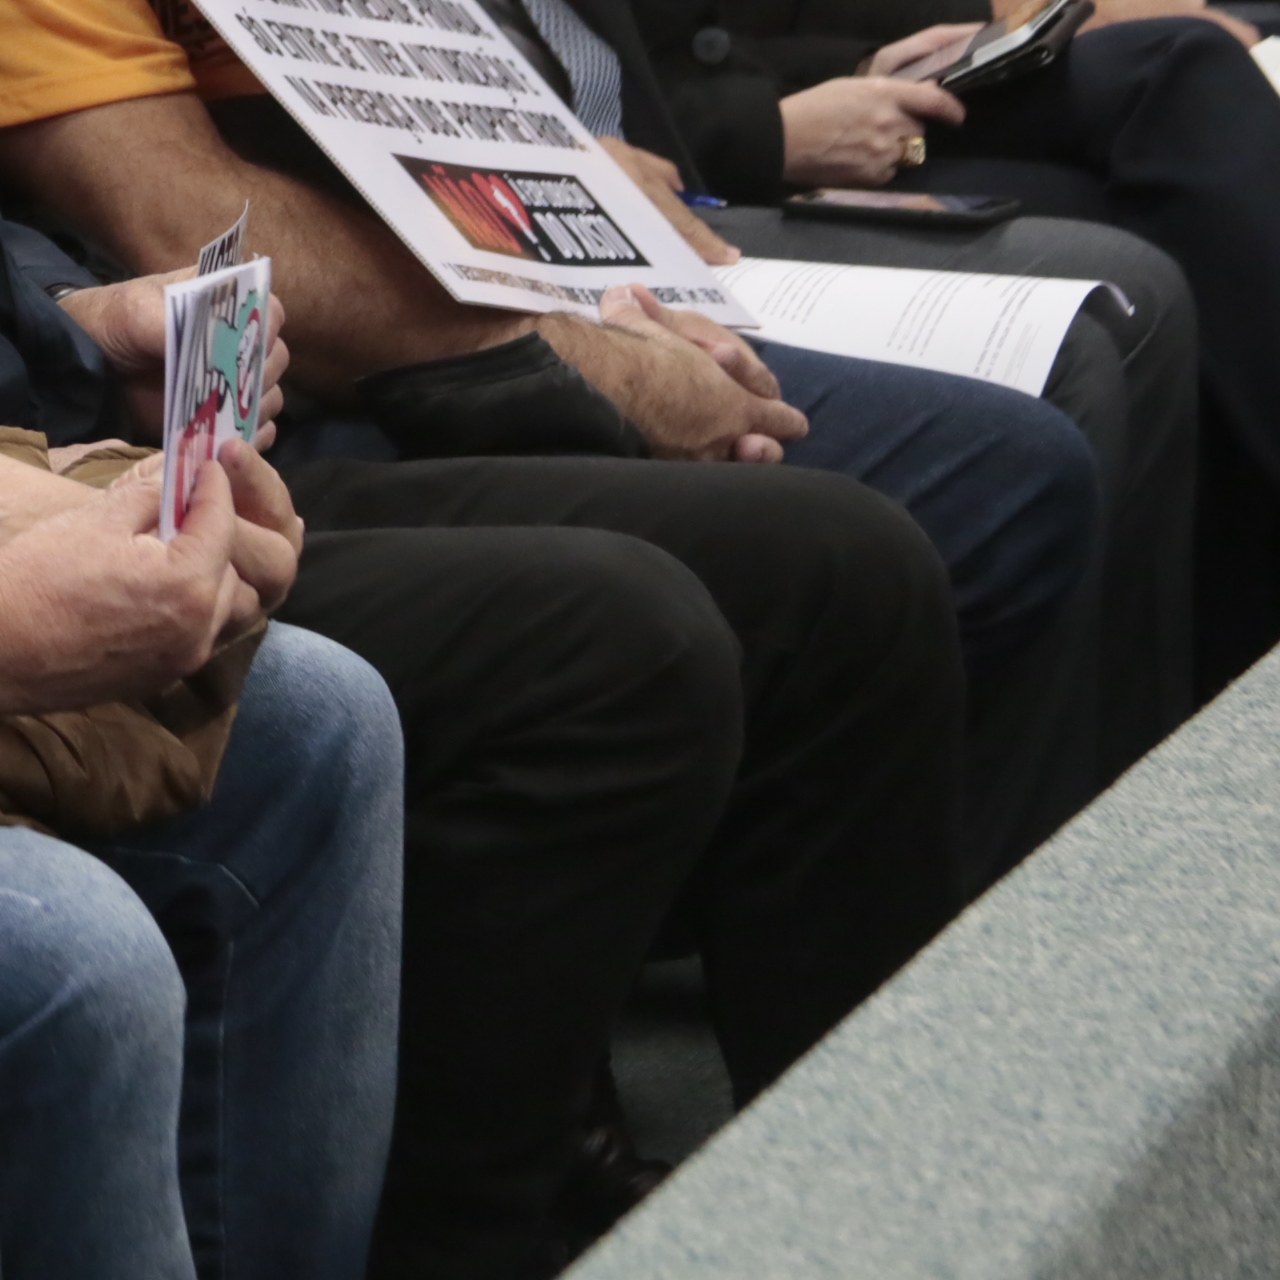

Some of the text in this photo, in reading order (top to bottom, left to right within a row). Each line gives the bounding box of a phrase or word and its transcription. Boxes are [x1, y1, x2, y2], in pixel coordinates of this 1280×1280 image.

[234, 6, 284, 57] SÓ
[262, 19, 342, 67] ENTRE
[320, 29, 367, 72] SE
[344, 34, 417, 78] TIVER
[398, 42, 527, 101] AUTORIZAÇÃO
[284, 74, 334, 117] NA
[314, 80, 426, 144] PRESENÇA
[403, 95, 462, 138] DOS
[532, 211, 636, 260] DO XISTO
